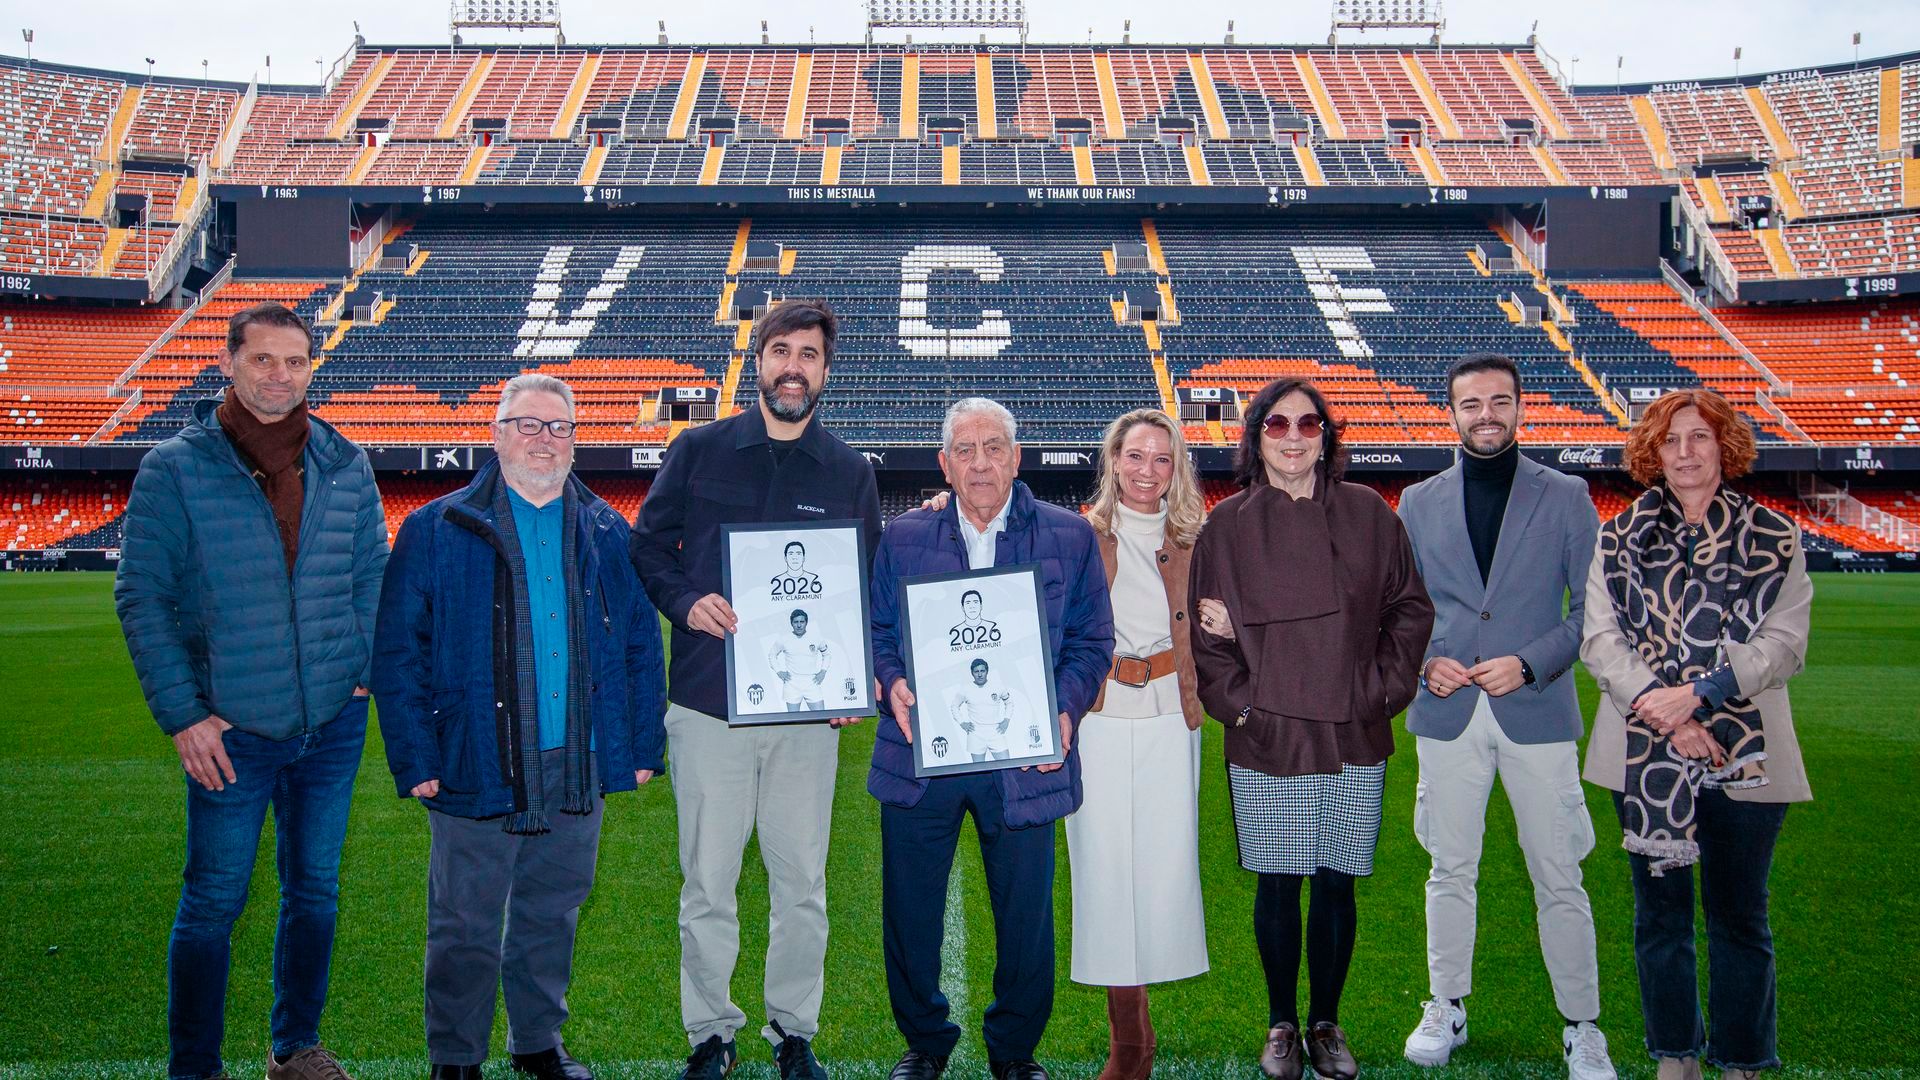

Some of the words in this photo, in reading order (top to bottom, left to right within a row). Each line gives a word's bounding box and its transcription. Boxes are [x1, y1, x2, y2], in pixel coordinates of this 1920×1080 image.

[1779, 69, 1822, 81] TURIA
[1665, 82, 1701, 91] TURIA
[274, 188, 298, 198] 1963
[437, 188, 461, 200] 1967
[599, 188, 622, 200] 1971
[788, 188, 810, 199] THIS
[813, 188, 823, 199] IS
[827, 188, 875, 199] MESTALLA
[1027, 188, 1043, 199] WE
[1046, 188, 1079, 199] THANK
[1082, 188, 1103, 199] OUR
[1106, 188, 1135, 199] FANS!
[1283, 189, 1307, 200] 1979
[1443, 189, 1467, 200] 1980
[1604, 188, 1628, 199] 1980
[0, 275, 31, 290] 1962
[1864, 278, 1896, 292] 1999
[635, 452, 649, 460] TM
[1042, 452, 1078, 464] PUMA
[15, 458, 54, 468] TURIA
[1844, 459, 1884, 469] TURIA
[770, 574, 823, 596] 2026
[949, 622, 1001, 646] 2026
[965, 641, 1002, 651] CLARAMUNT
